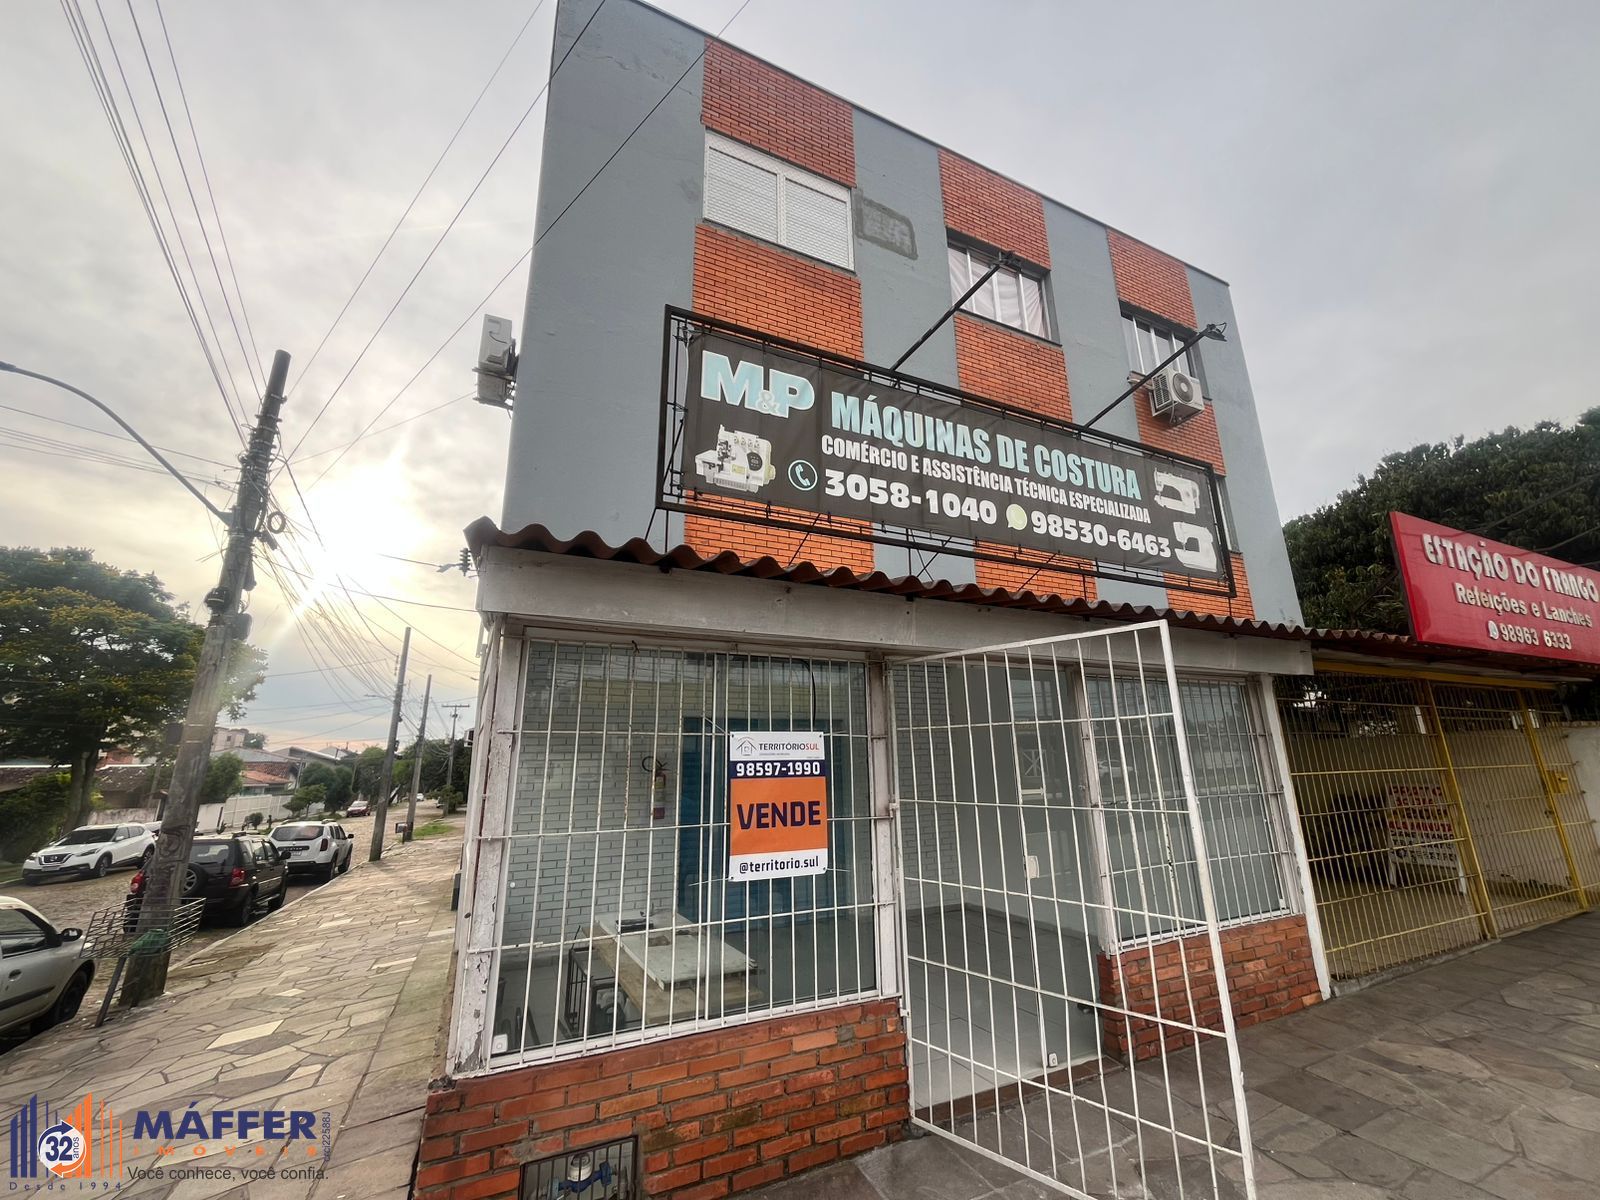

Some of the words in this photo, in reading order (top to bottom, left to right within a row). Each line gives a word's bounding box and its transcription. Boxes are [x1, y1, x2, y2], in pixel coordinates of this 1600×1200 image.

[700, 349, 815, 418] M&P
[831, 391, 992, 464] MÁQUINAS
[996, 433, 1030, 473] DE
[1034, 444, 1142, 500] COSTURA
[821, 434, 908, 471] COMÉRCIO
[911, 454, 921, 474] E
[922, 457, 1013, 494] ASSISTÊNCIA
[1014, 476, 1067, 506] TÉCNICA
[1069, 490, 1151, 523] ESPECIALIZADA
[825, 468, 998, 525] 3058-1040
[1030, 510, 1171, 558] 98530-6463
[1422, 533, 1509, 581] ESTAÇÃO
[1509, 556, 1540, 588] DO
[1541, 565, 1600, 602] FRANGO
[1454, 582, 1527, 615] Refeições
[1531, 602, 1541, 617] e
[1542, 601, 1593, 628] Lanches
[1500, 622, 1539, 646] 98963
[1543, 630, 1572, 650] 6333
[736, 761, 821, 777] 98597-1990
[736, 800, 822, 829] VENDE
[739, 856, 820, 874] @territorio.sul
